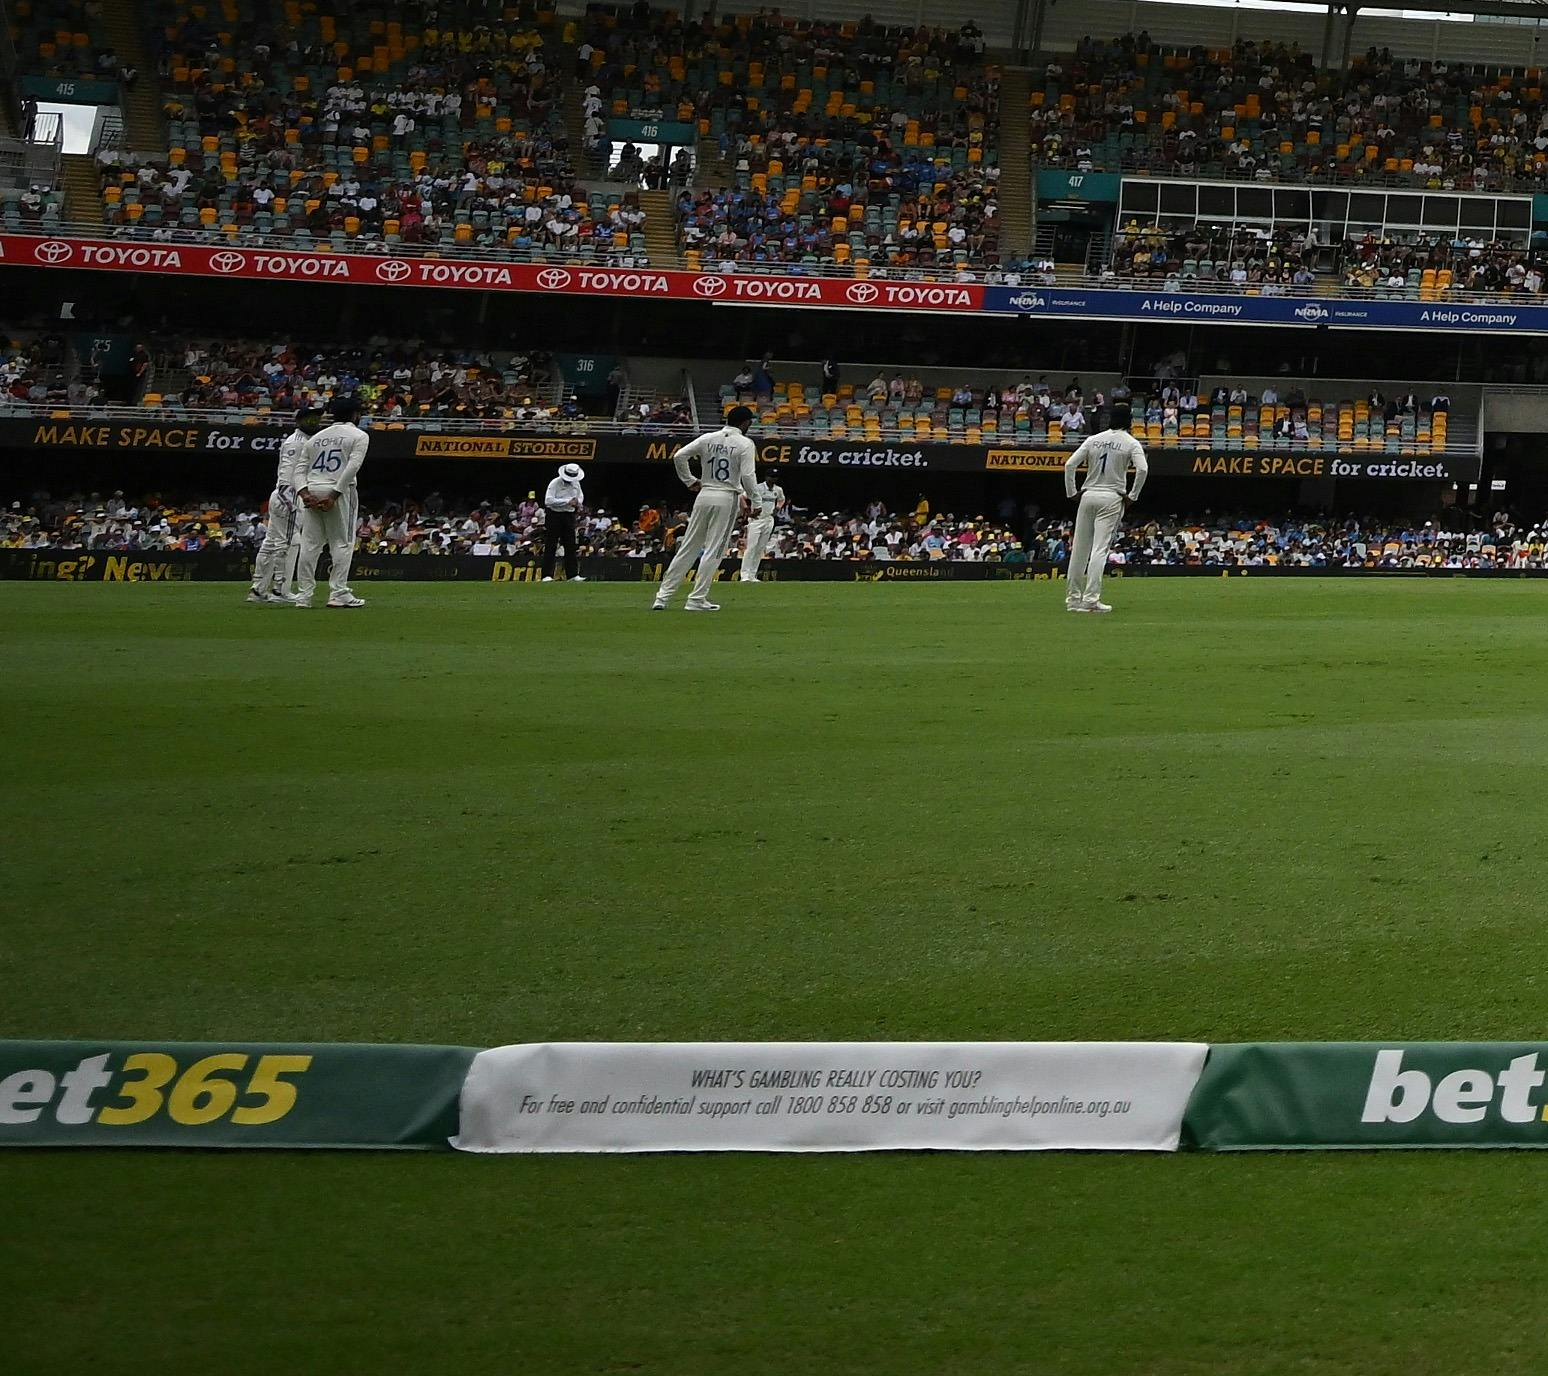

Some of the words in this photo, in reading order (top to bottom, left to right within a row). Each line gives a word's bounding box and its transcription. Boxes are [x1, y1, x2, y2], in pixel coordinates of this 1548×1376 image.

[56, 82, 74, 96] 415
[641, 125, 657, 137] 416
[1067, 176, 1083, 188] 417
[81, 247, 182, 268] TOYOTA
[254, 256, 350, 277] TOYOTA
[420, 264, 512, 285] TOYOTA
[578, 273, 669, 292] TOYOTA
[733, 280, 822, 299] TOYOTA
[886, 288, 971, 305] TOYOTA
[1010, 297, 1044, 308] NRMA
[1142, 301, 1151, 310] A
[1155, 300, 1183, 314] Help
[1185, 302, 1241, 315] Company
[1295, 307, 1328, 318] NRMA
[576, 359, 593, 372] 316
[35, 425, 109, 447] MAKE
[118, 427, 198, 448] SPACE
[205, 432, 245, 450] for
[314, 435, 346, 448] ROHIT
[421, 437, 507, 456] NATIONAL
[513, 441, 590, 455] STORAGE
[707, 444, 736, 455] VIRAT
[312, 449, 342, 473] 45
[707, 458, 729, 480] 18
[1100, 452, 1107, 473] 1
[1193, 457, 1252, 473] MAKE
[1260, 458, 1324, 475] SPACE
[1330, 459, 1362, 476] for
[1367, 461, 1449, 479] cricket.
[691, 1070, 745, 1088] WHAT'S
[749, 1070, 821, 1088] GAMBLING
[825, 1070, 874, 1088] REALLY
[879, 1070, 938, 1088] COSTING
[944, 1070, 982, 1088] YOU?
[0, 1054, 312, 1125] et365
[520, 1095, 544, 1114] For
[548, 1094, 574, 1114] free
[580, 1096, 609, 1114] and
[612, 1095, 695, 1115] confidential
[697, 1098, 750, 1118] support
[755, 1096, 782, 1115] call
[787, 1096, 822, 1114] 1800
[827, 1096, 857, 1114] 858
[862, 1096, 892, 1114] 858
[897, 1101, 911, 1115] or
[917, 1098, 944, 1115] visit
[948, 1096, 1131, 1118] gamblinghelponline.org.au
